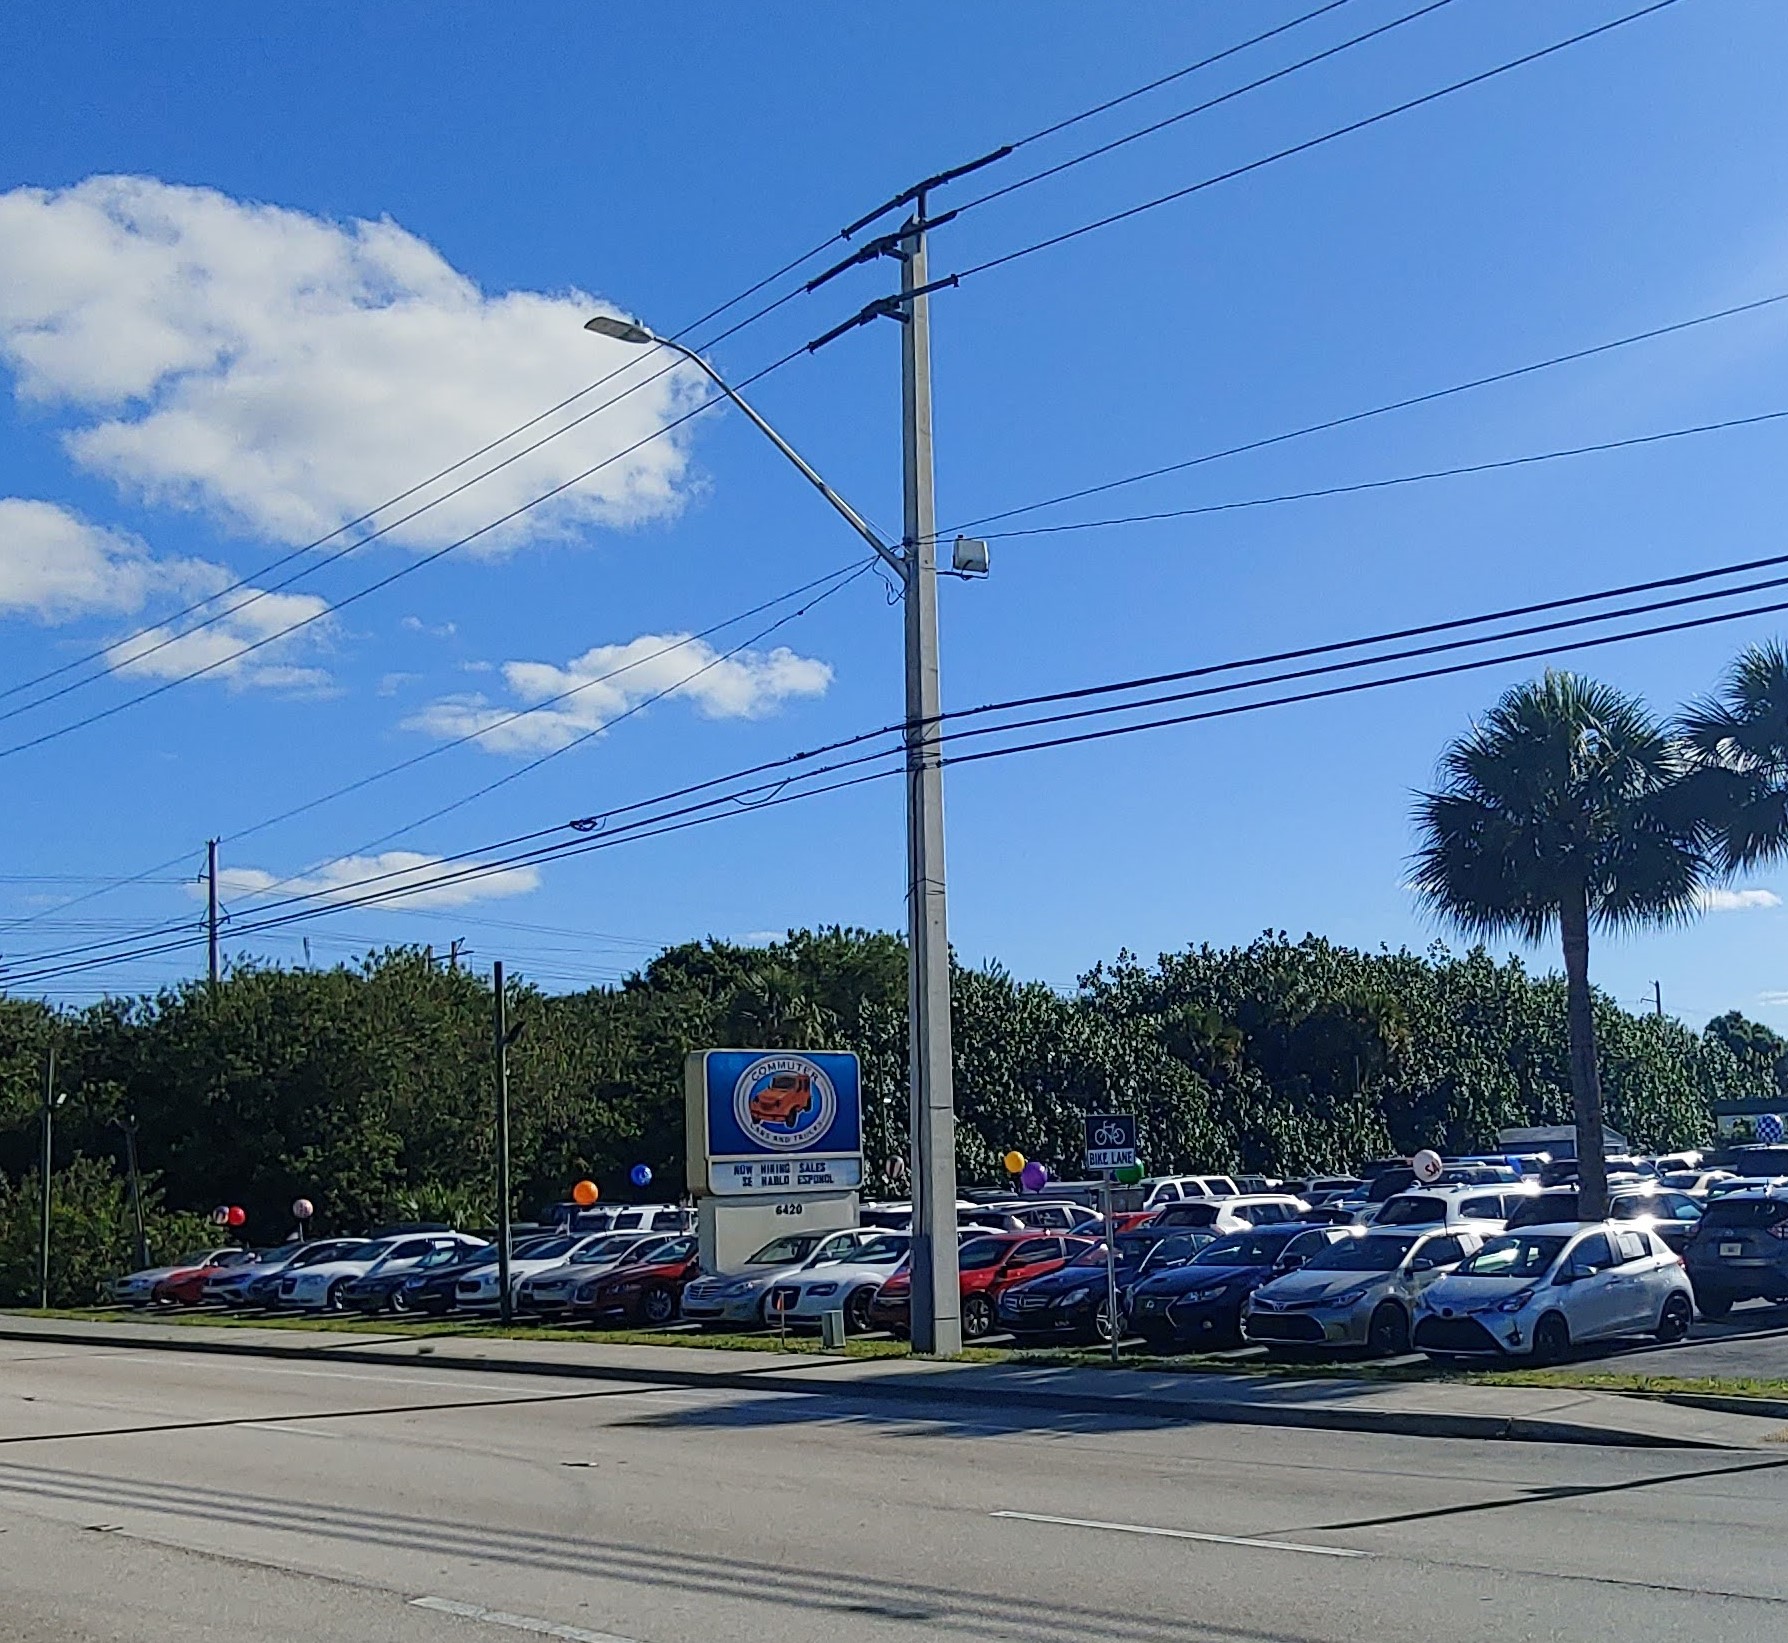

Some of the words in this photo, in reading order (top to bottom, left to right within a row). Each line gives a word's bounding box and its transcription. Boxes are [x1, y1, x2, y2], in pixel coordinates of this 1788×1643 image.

[751, 1061, 819, 1081] COMMUTER
[774, 1135, 790, 1143] AND
[1089, 1151, 1108, 1165] BIKE
[1111, 1151, 1132, 1165] LANE
[734, 1165, 753, 1175] NOW
[760, 1163, 790, 1174] HIRING
[799, 1162, 826, 1173] SALES
[742, 1176, 753, 1187] SE
[776, 1204, 803, 1215] 6420
